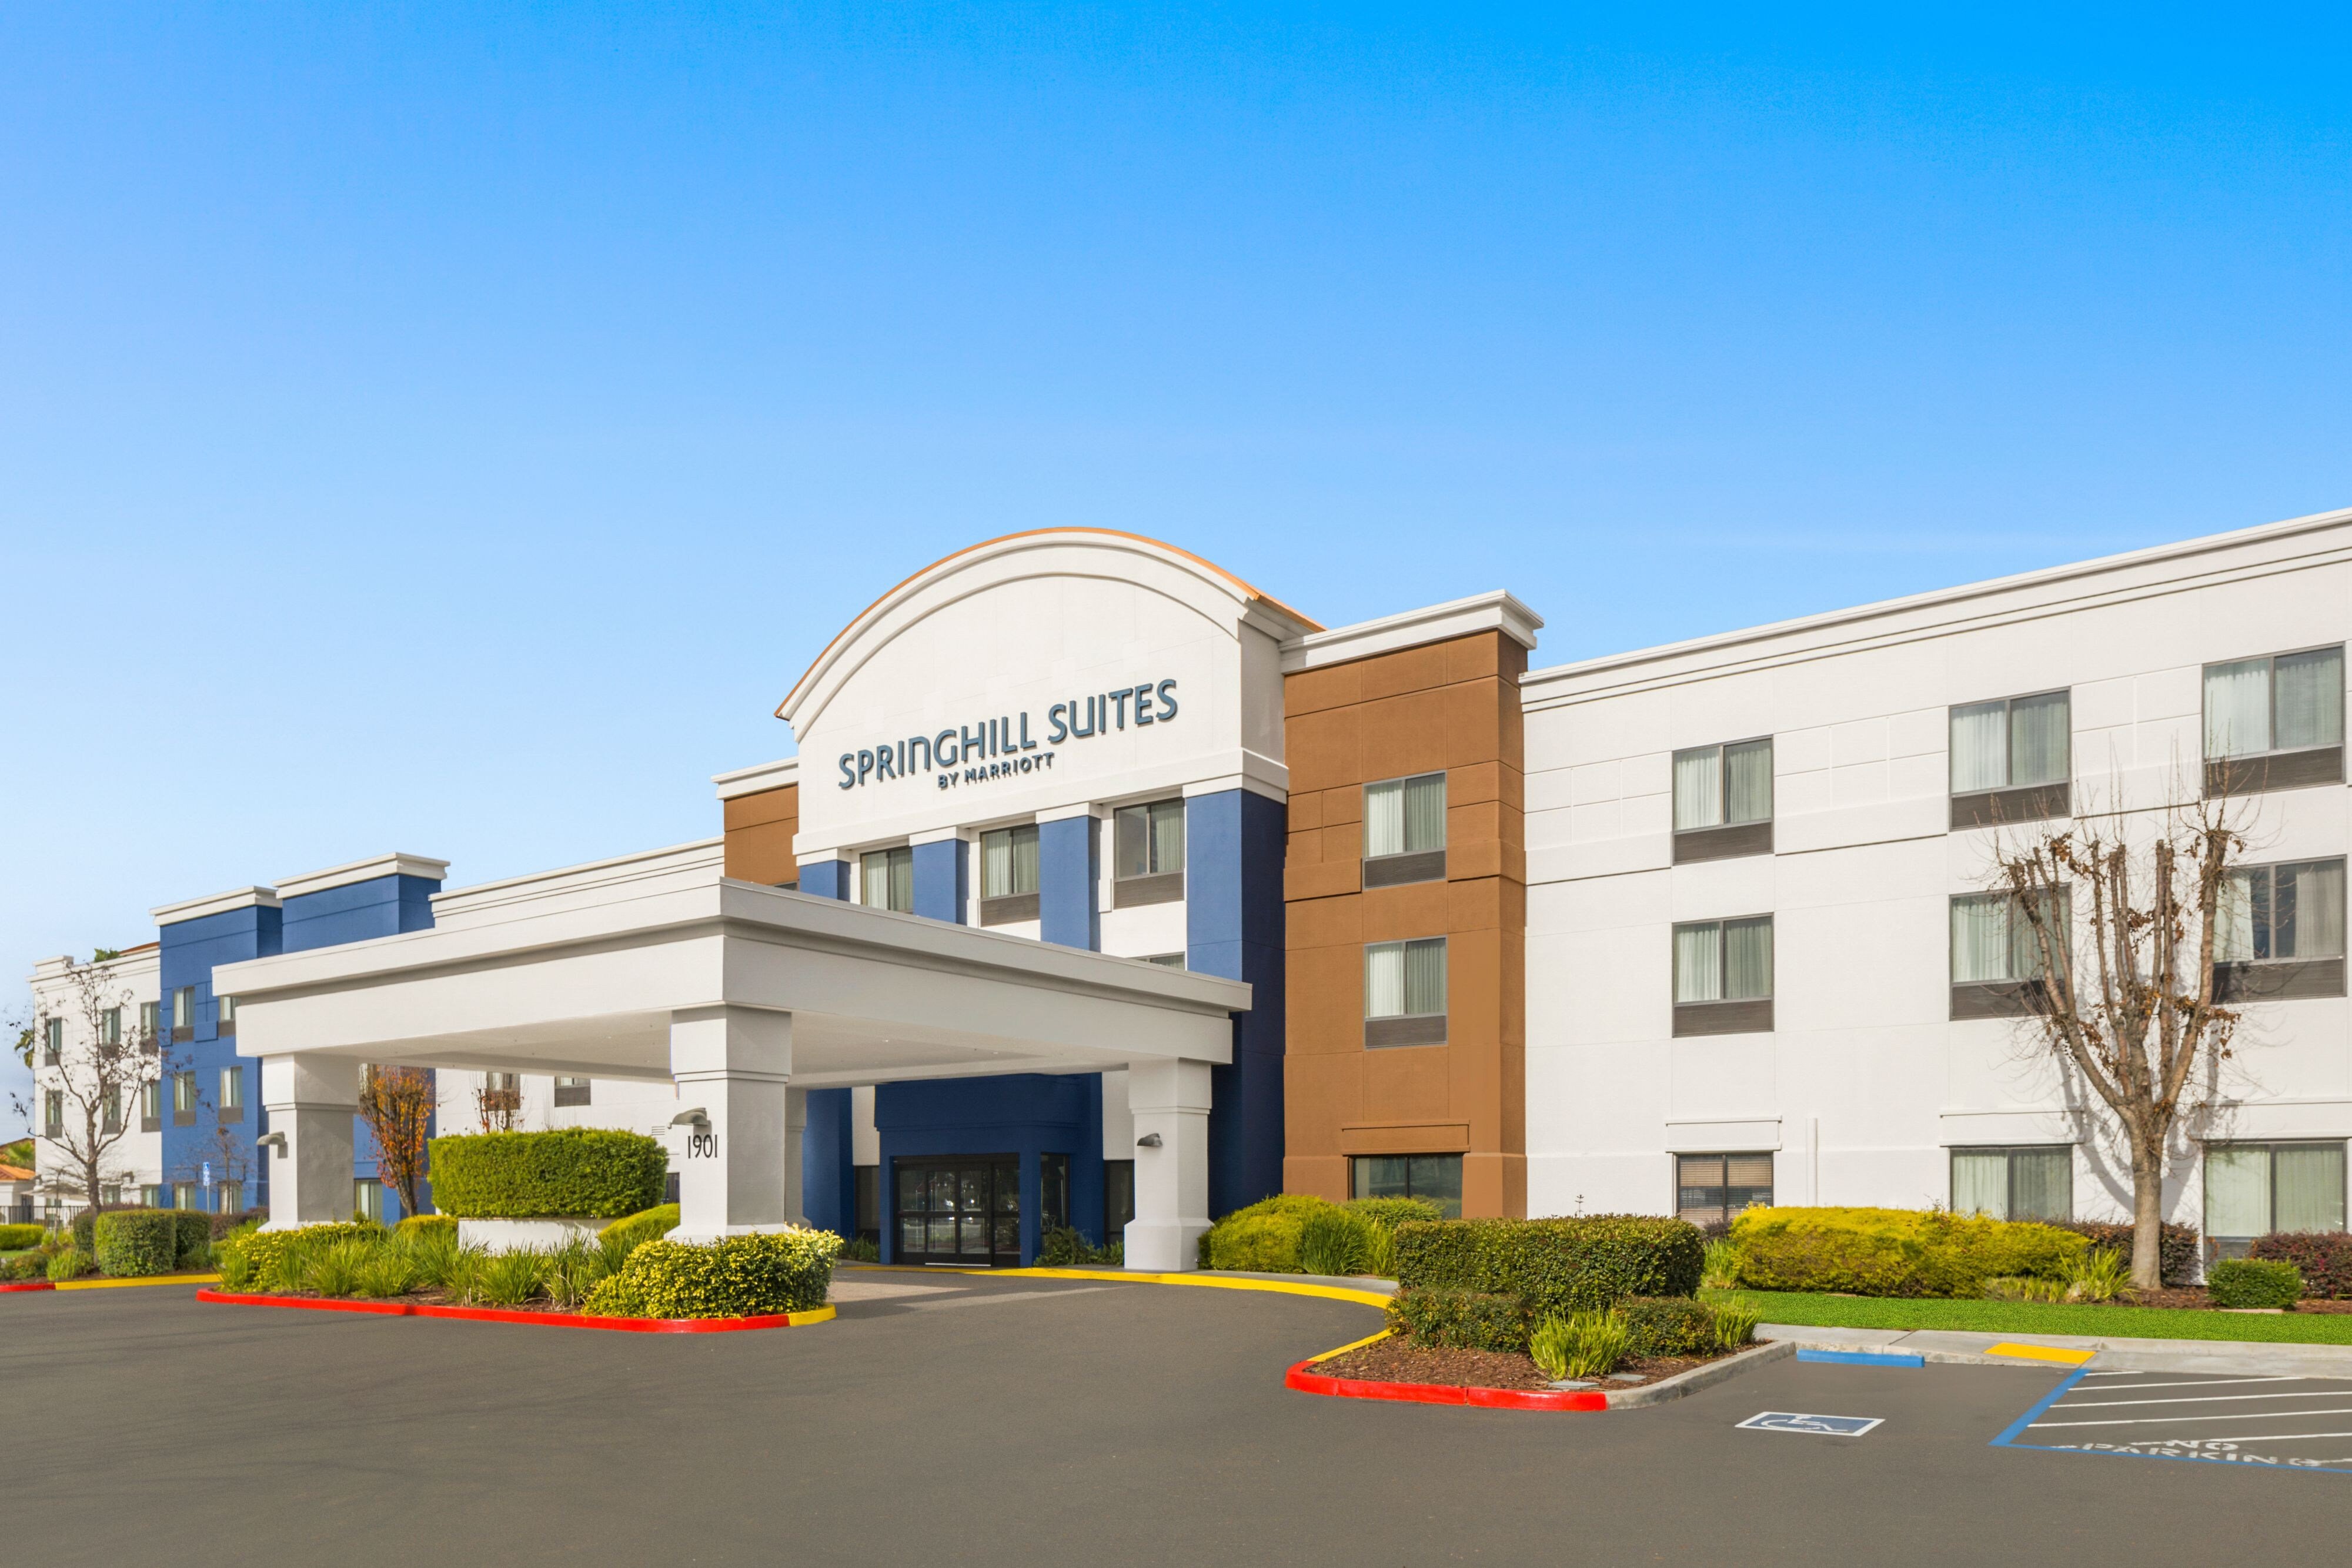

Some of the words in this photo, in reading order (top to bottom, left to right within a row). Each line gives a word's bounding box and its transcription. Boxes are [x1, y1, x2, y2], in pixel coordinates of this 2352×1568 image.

[838, 711, 1037, 789] SPRINGHILL
[1047, 678, 1178, 744] SUITES
[938, 771, 959, 788] BY
[964, 751, 1055, 785] MARRIOTT
[688, 1134, 717, 1159] 1901
[2082, 1443, 2321, 1467] PARKING
[2166, 1439, 2239, 1450] NO
